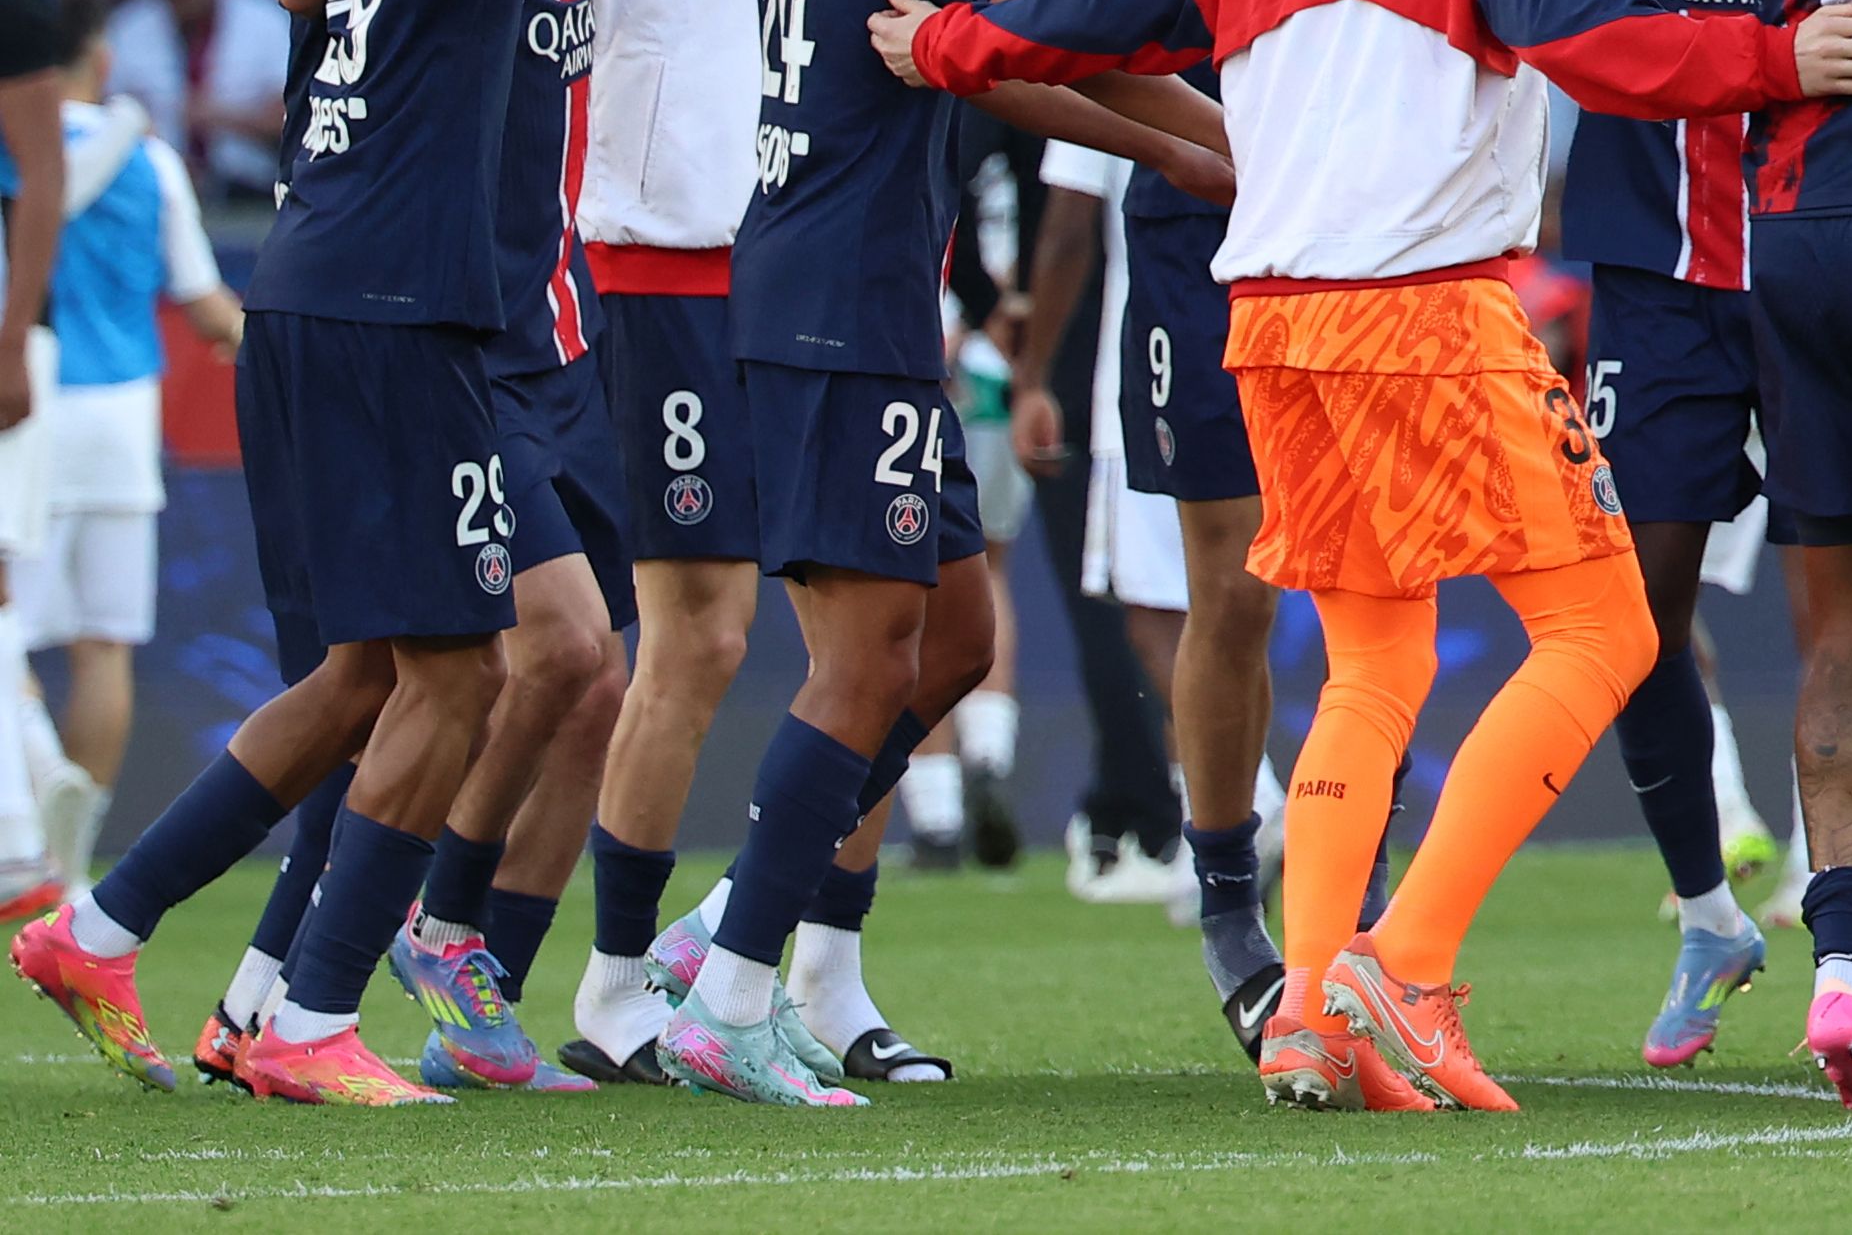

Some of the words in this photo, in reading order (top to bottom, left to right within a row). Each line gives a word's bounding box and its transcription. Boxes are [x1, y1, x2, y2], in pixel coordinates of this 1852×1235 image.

[1149, 326, 1172, 408] 9
[1584, 360, 1623, 439] 5
[663, 390, 706, 471] 8
[874, 401, 943, 494] 24
[895, 497, 923, 511] PARIS
[1295, 779, 1347, 800] PARIS
